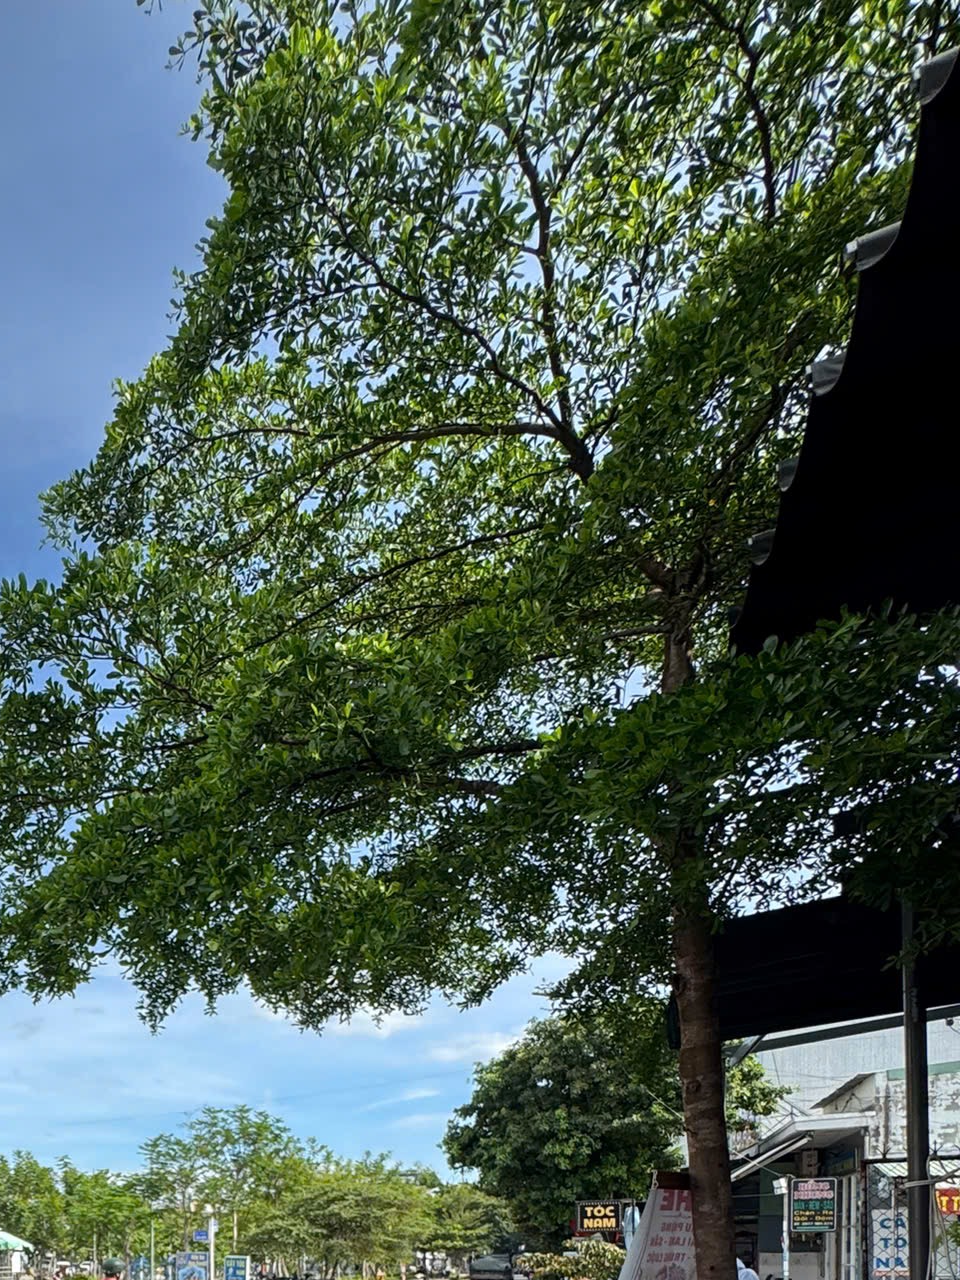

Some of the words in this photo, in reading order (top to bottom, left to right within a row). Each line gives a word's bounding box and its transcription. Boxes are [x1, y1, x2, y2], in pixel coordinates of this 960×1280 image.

[584, 1204, 615, 1217] TÓC
[583, 1218, 616, 1229] NAM
[876, 1257, 907, 1268] NA
